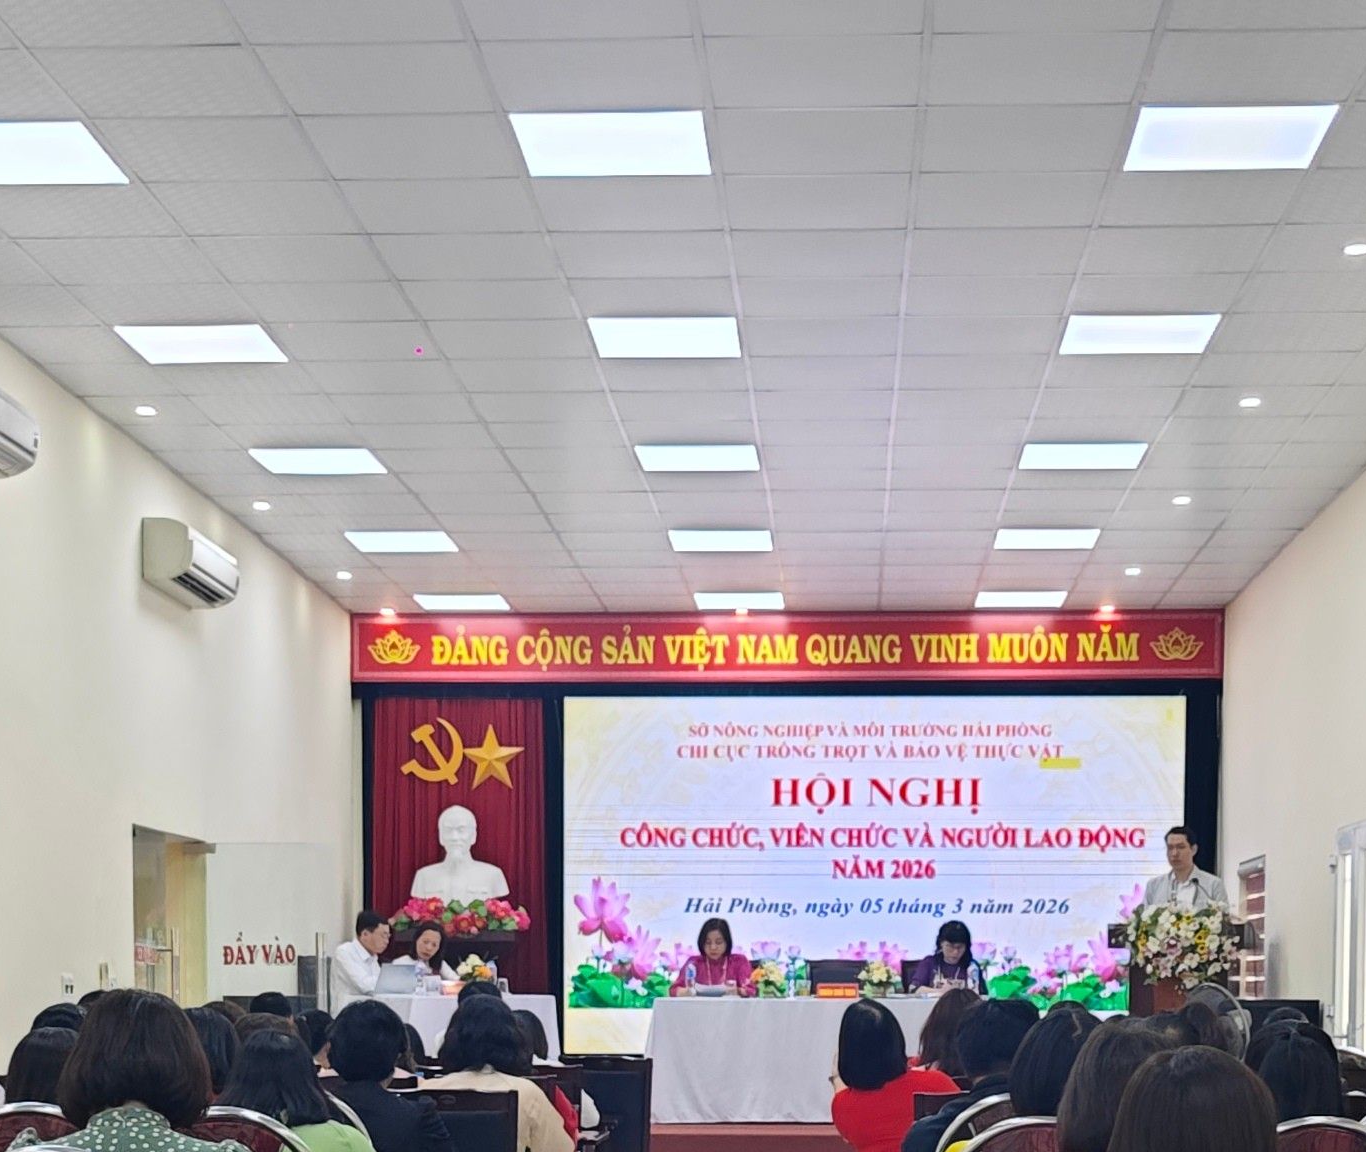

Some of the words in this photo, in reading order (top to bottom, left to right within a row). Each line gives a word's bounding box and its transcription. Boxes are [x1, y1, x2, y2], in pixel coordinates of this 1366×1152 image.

[430, 625, 509, 666] ĐẢNG
[516, 628, 593, 672] CỘNG
[601, 624, 656, 666] SẢN
[663, 626, 730, 672] VIỆT
[737, 634, 799, 665] NAM
[805, 633, 903, 666] QUANG
[910, 633, 979, 664] VINH
[987, 625, 1068, 664] MUÔN
[1076, 624, 1140, 664] NĂM
[713, 721, 759, 738] NÔNG
[763, 722, 825, 741] NGHIỆP
[827, 721, 849, 738] VÀ
[853, 721, 885, 738] MÔI
[889, 721, 958, 738] TRƯỜNG
[962, 721, 992, 738] HẢI
[996, 721, 1052, 738] PHÒNG
[676, 745, 709, 760] CHI
[713, 745, 750, 763] CỤC
[755, 741, 817, 760] TRỒNG
[821, 745, 870, 763] TRỌT
[874, 741, 898, 759] VÀ
[903, 741, 940, 759] BẢO
[945, 742, 968, 763] VỆ
[972, 743, 1024, 762] THỰC
[1027, 742, 1064, 763] VẬT
[770, 772, 853, 816] HỘI
[866, 776, 983, 816] NGHỊ
[619, 822, 687, 849] CÔNG
[691, 822, 766, 852] CHỨC,
[769, 822, 825, 849] VIÊN
[830, 822, 899, 849] CHỨC
[903, 822, 935, 849] VÀ
[940, 822, 1019, 849] NGƯỜI
[1023, 827, 1072, 849] LAO
[1078, 825, 1146, 853] ĐỘNG
[831, 855, 885, 880] NĂM
[890, 859, 936, 880] 2026
[683, 897, 722, 914] Hải
[727, 898, 798, 918] Phòng,
[804, 899, 855, 918] ngày
[860, 898, 883, 914] 05
[887, 898, 946, 918] tháng
[951, 898, 964, 914] 3
[969, 900, 1014, 914] năm
[1021, 898, 1070, 914] 2026
[223, 932, 257, 965] ĐẨY
[261, 936, 296, 965] VÀO
